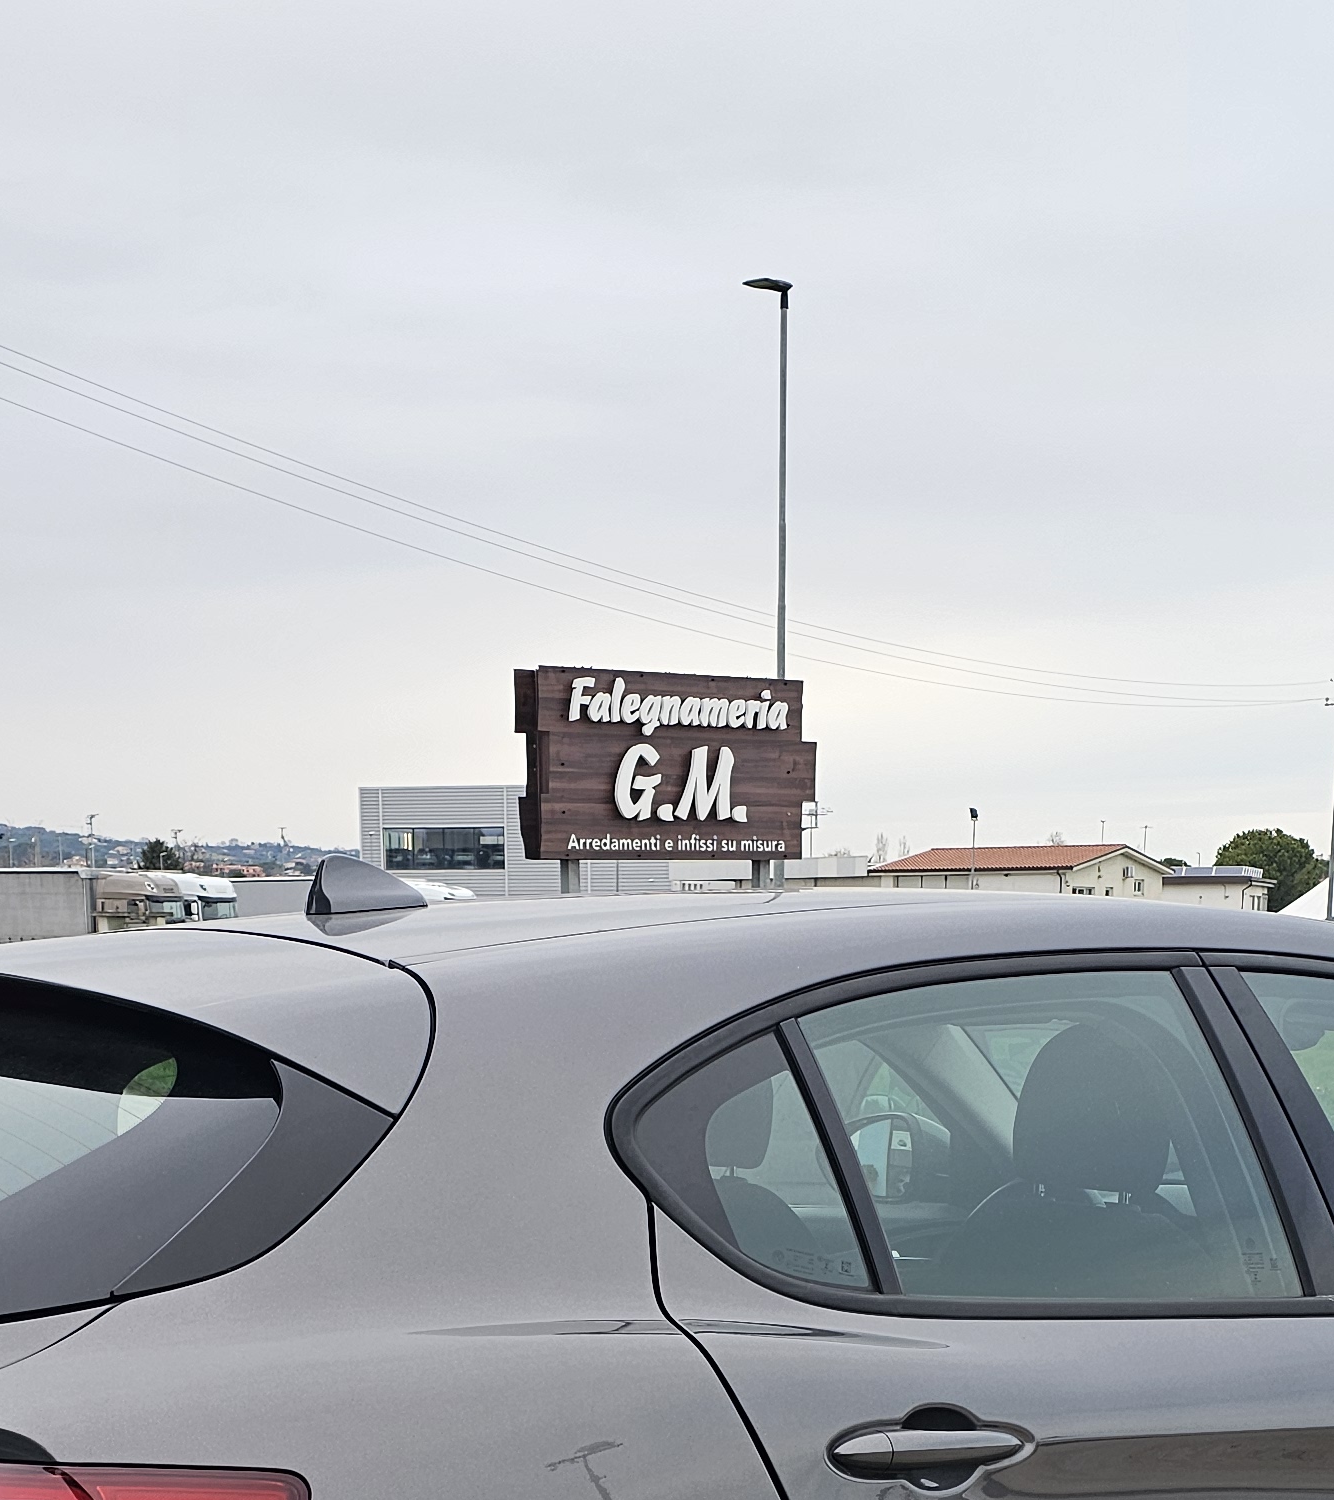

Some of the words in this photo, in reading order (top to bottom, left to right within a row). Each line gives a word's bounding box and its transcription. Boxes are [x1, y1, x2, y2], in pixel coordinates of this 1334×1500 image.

[568, 676, 789, 736] Falegnameria
[614, 743, 748, 823] G.M.
[567, 833, 661, 852] Arredamenti
[665, 838, 674, 852] e
[678, 834, 717, 852] infissi
[721, 838, 737, 852] su
[740, 835, 786, 852] misura
